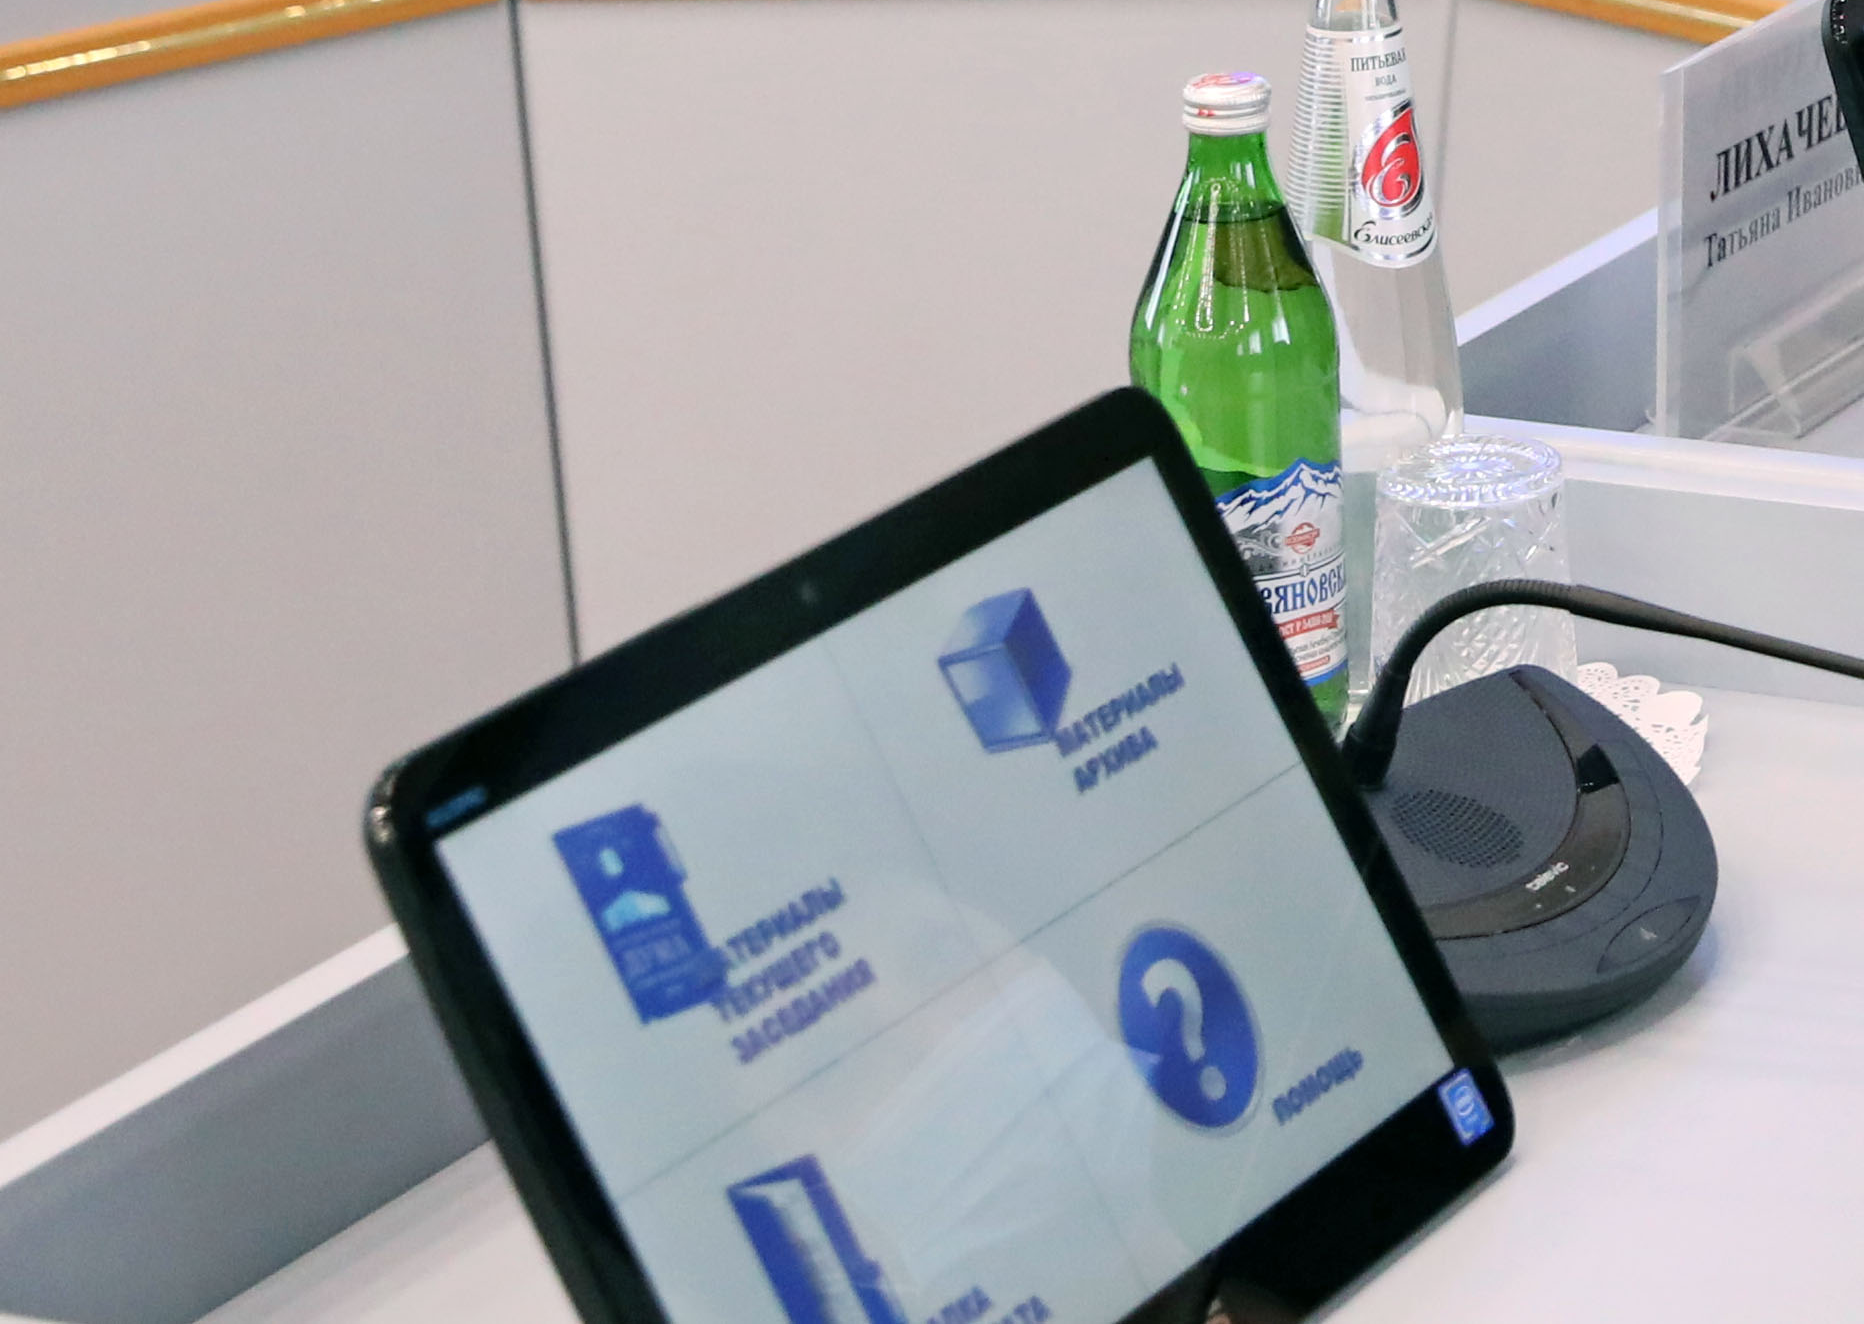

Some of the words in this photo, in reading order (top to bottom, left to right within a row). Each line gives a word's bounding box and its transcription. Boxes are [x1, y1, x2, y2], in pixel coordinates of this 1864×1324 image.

[1375, 73, 1398, 87] ВОДА
[1704, 206, 1781, 268] Татьяна
[1057, 661, 1185, 758] МАТЕРИАЛЫ
[1073, 724, 1159, 793] АРХИВА
[1272, 1047, 1364, 1127] ПОМОЩЬ
